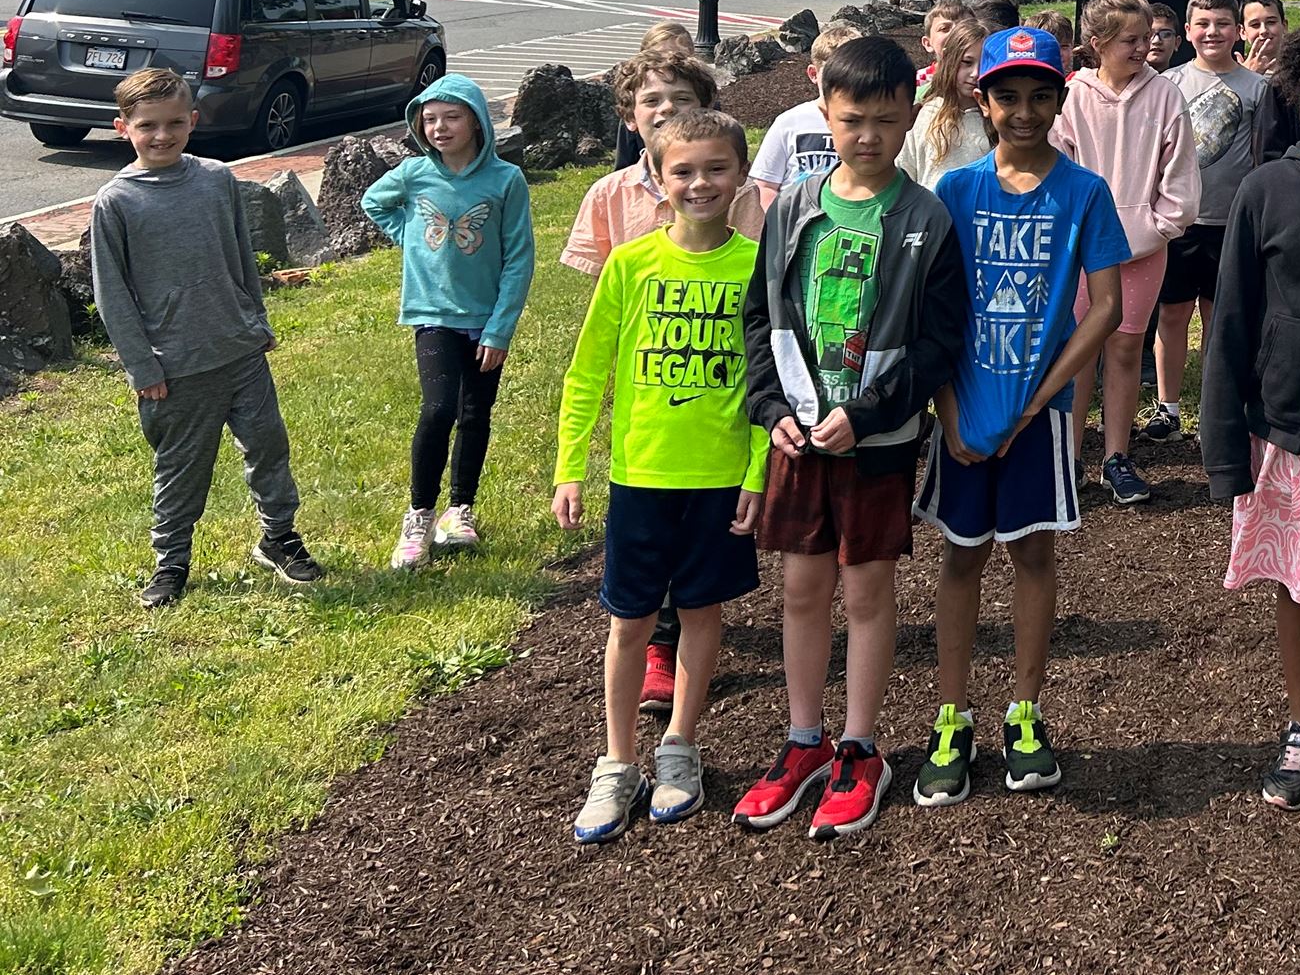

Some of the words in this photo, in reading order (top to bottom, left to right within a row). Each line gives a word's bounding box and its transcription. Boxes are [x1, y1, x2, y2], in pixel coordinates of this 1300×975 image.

[972, 217, 1054, 260] TAKE
[646, 279, 743, 316] LEAVE
[648, 316, 735, 352] YOUR
[633, 350, 744, 388] LEGACY
[846, 350, 861, 364] TNT
